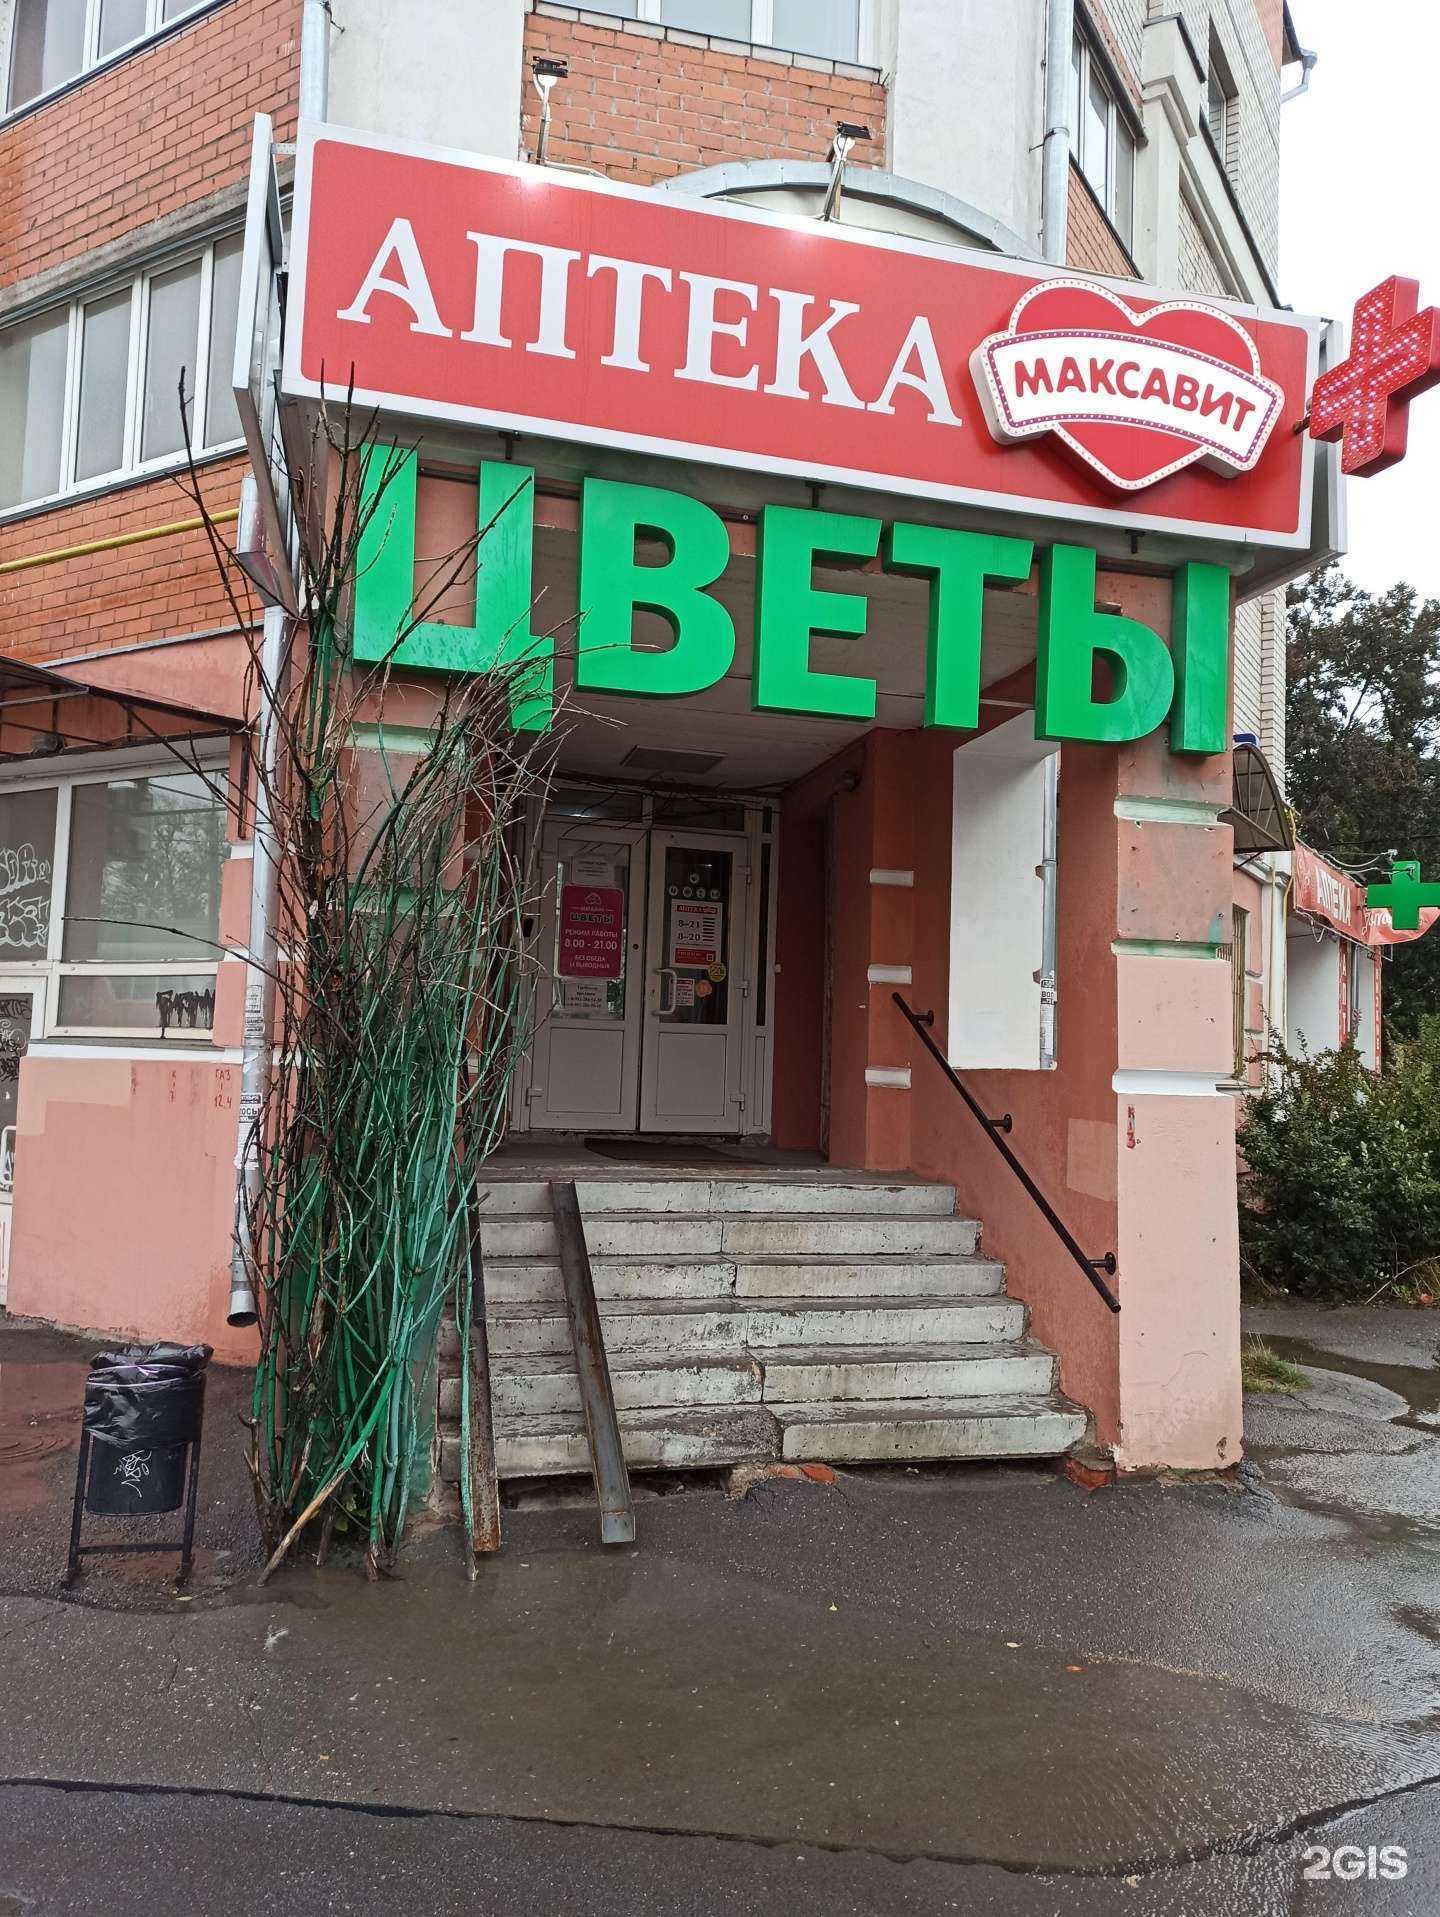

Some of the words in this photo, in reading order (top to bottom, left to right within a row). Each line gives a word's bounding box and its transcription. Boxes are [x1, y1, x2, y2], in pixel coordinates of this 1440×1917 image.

[336, 216, 963, 427] АПТЕКА
[1014, 356, 1255, 432] МАКСАВИТ
[352, 442, 1231, 754] ЦВЕТЫ
[215, 1069, 231, 1081] ГАЗ
